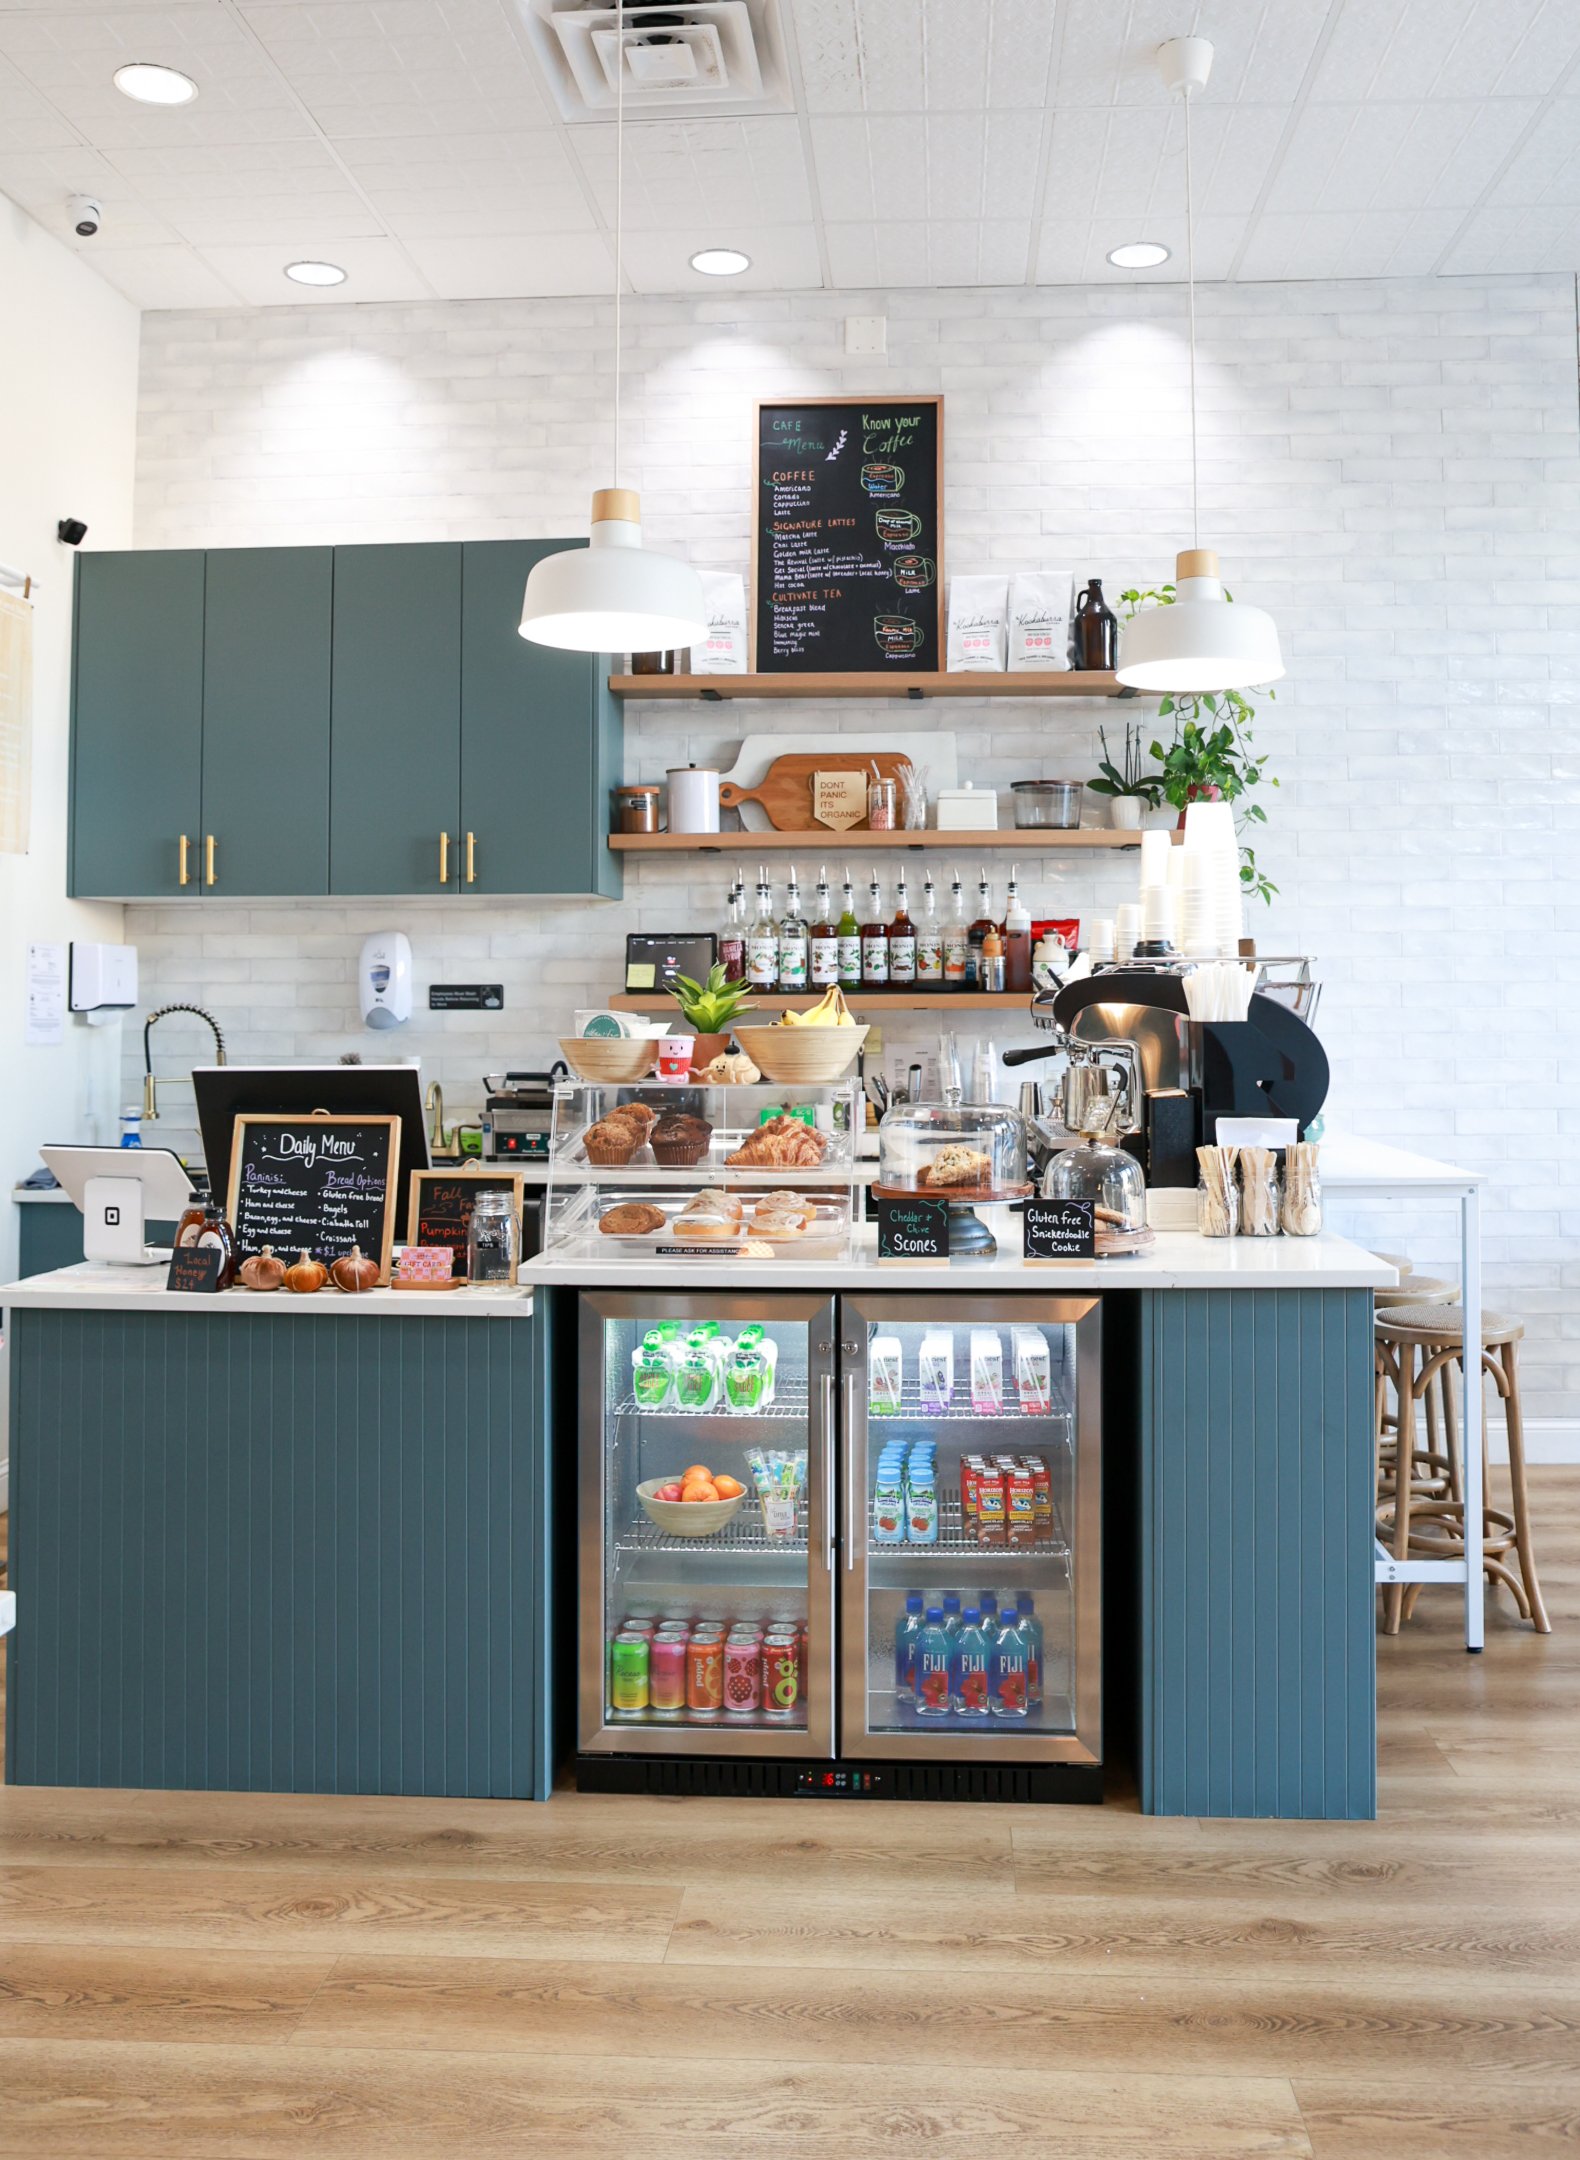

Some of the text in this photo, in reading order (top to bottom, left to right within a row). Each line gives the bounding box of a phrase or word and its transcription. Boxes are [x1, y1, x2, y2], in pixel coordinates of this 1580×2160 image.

[772, 420, 802, 432] CAFE
[862, 414, 922, 433] Know your
[783, 436, 825, 454] Menu
[863, 433, 914, 454] Coffee
[772, 471, 816, 482] COFFEE
[774, 518, 856, 530] SIGNATURE LATTES
[774, 550, 797, 558] Golden
[772, 589, 842, 602] CULTIVATE TEA
[774, 604, 806, 615] Breakfast
[1018, 611, 1063, 627] Kookaburra
[774, 646, 789, 657] Berry
[820, 810, 861, 818] ORGANIC
[280, 1134, 356, 1168] Daily Menu
[245, 1163, 284, 1182] Paninis:
[326, 1170, 386, 1190] Bread Options
[247, 1184, 272, 1198] Turkey
[323, 1190, 384, 1202] Gluten free bread
[434, 1186, 462, 1201] Fall
[245, 1198, 261, 1208] Ham
[324, 1204, 348, 1218] Bagels
[890, 1210, 923, 1223] Cheddar
[1028, 1208, 1060, 1225] Gluten
[295, 1216, 318, 1224] cheese
[322, 1217, 354, 1228] Ciabatta
[242, 1224, 256, 1238] Egg
[906, 1223, 930, 1234] Chive
[1032, 1225, 1090, 1240] Snickerdoodle
[320, 1231, 357, 1243] Croissant
[894, 1234, 937, 1253] Scones
[1052, 1242, 1081, 1252] Cookie
[184, 1253, 211, 1265] Local
[176, 1264, 207, 1280] Honey
[923, 1654, 946, 1672] FIJI
[962, 1654, 985, 1672] FIJI
[1000, 1656, 1023, 1673] FIJI
[694, 1657, 704, 1688] poppi
